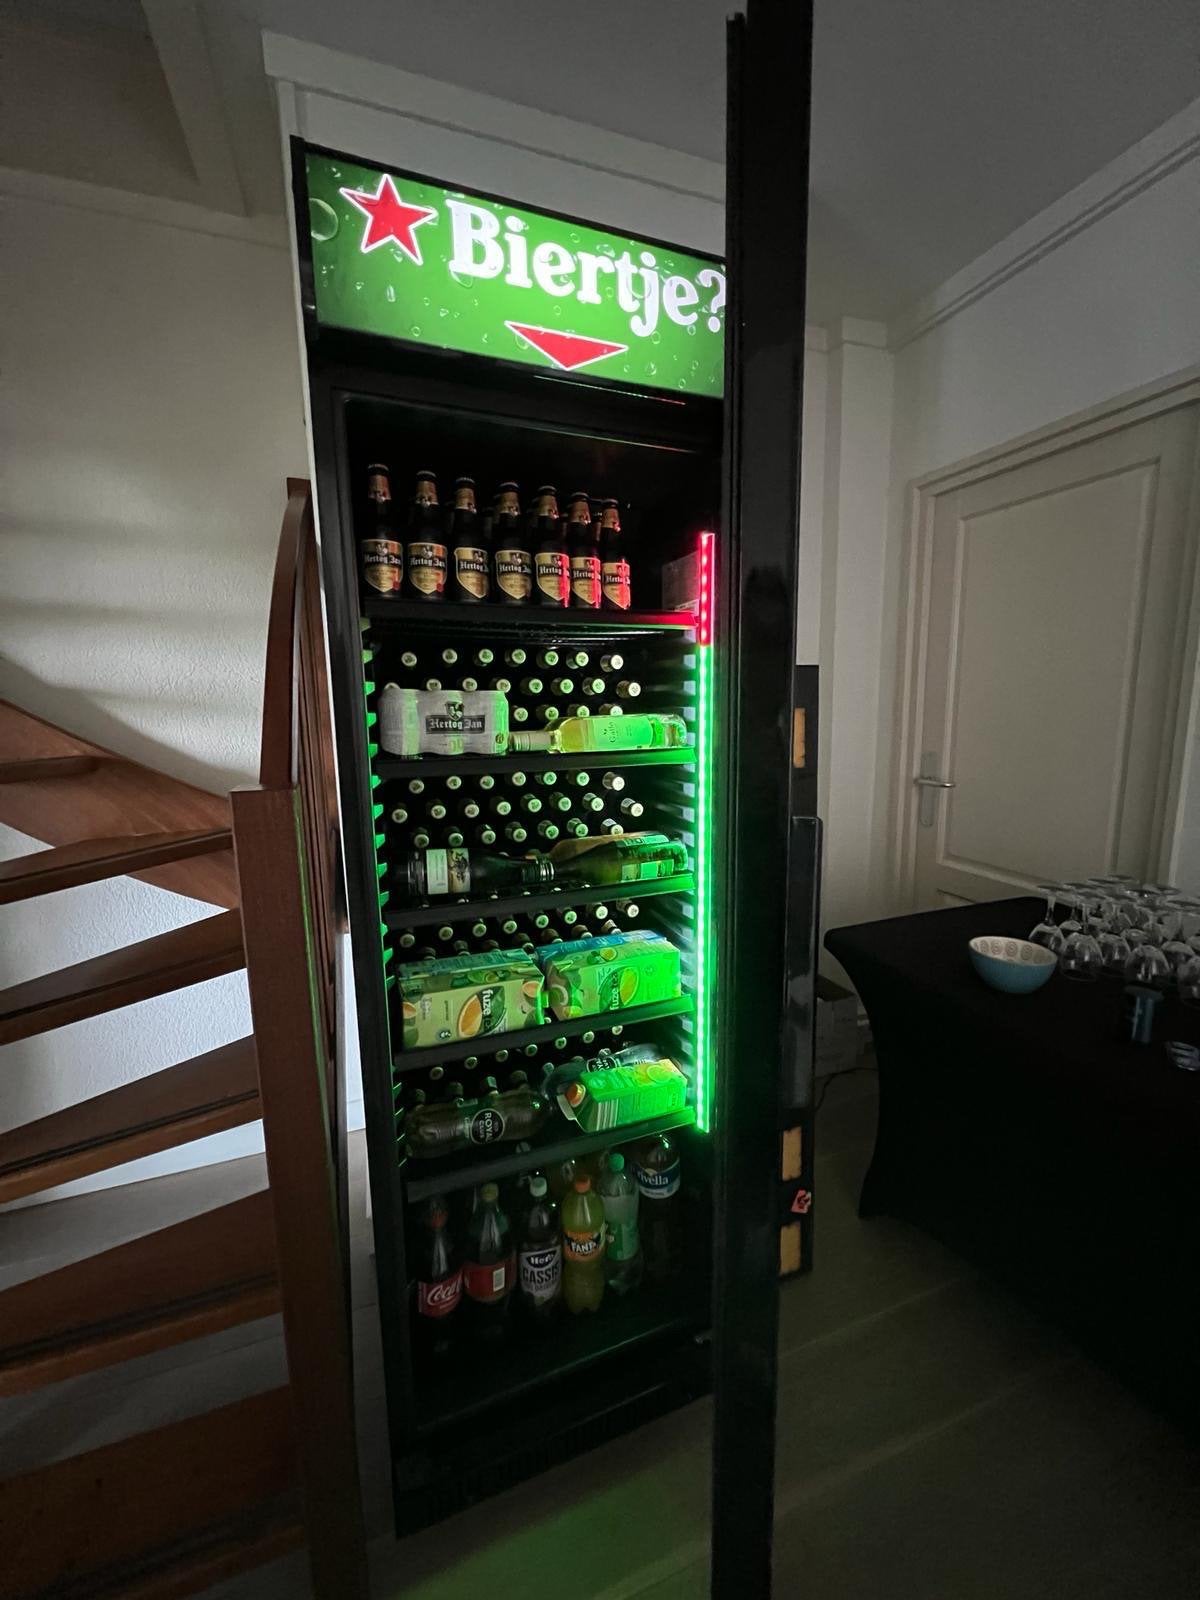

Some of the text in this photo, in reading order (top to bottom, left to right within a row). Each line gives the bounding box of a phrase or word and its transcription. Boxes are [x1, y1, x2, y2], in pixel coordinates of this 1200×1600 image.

[446, 198, 726, 338] Biertje?
[428, 718, 483, 730] Hertog Jan
[481, 988, 494, 1016] fuze
[609, 987, 619, 1011] fuze
[484, 1111, 493, 1143] ROYAL
